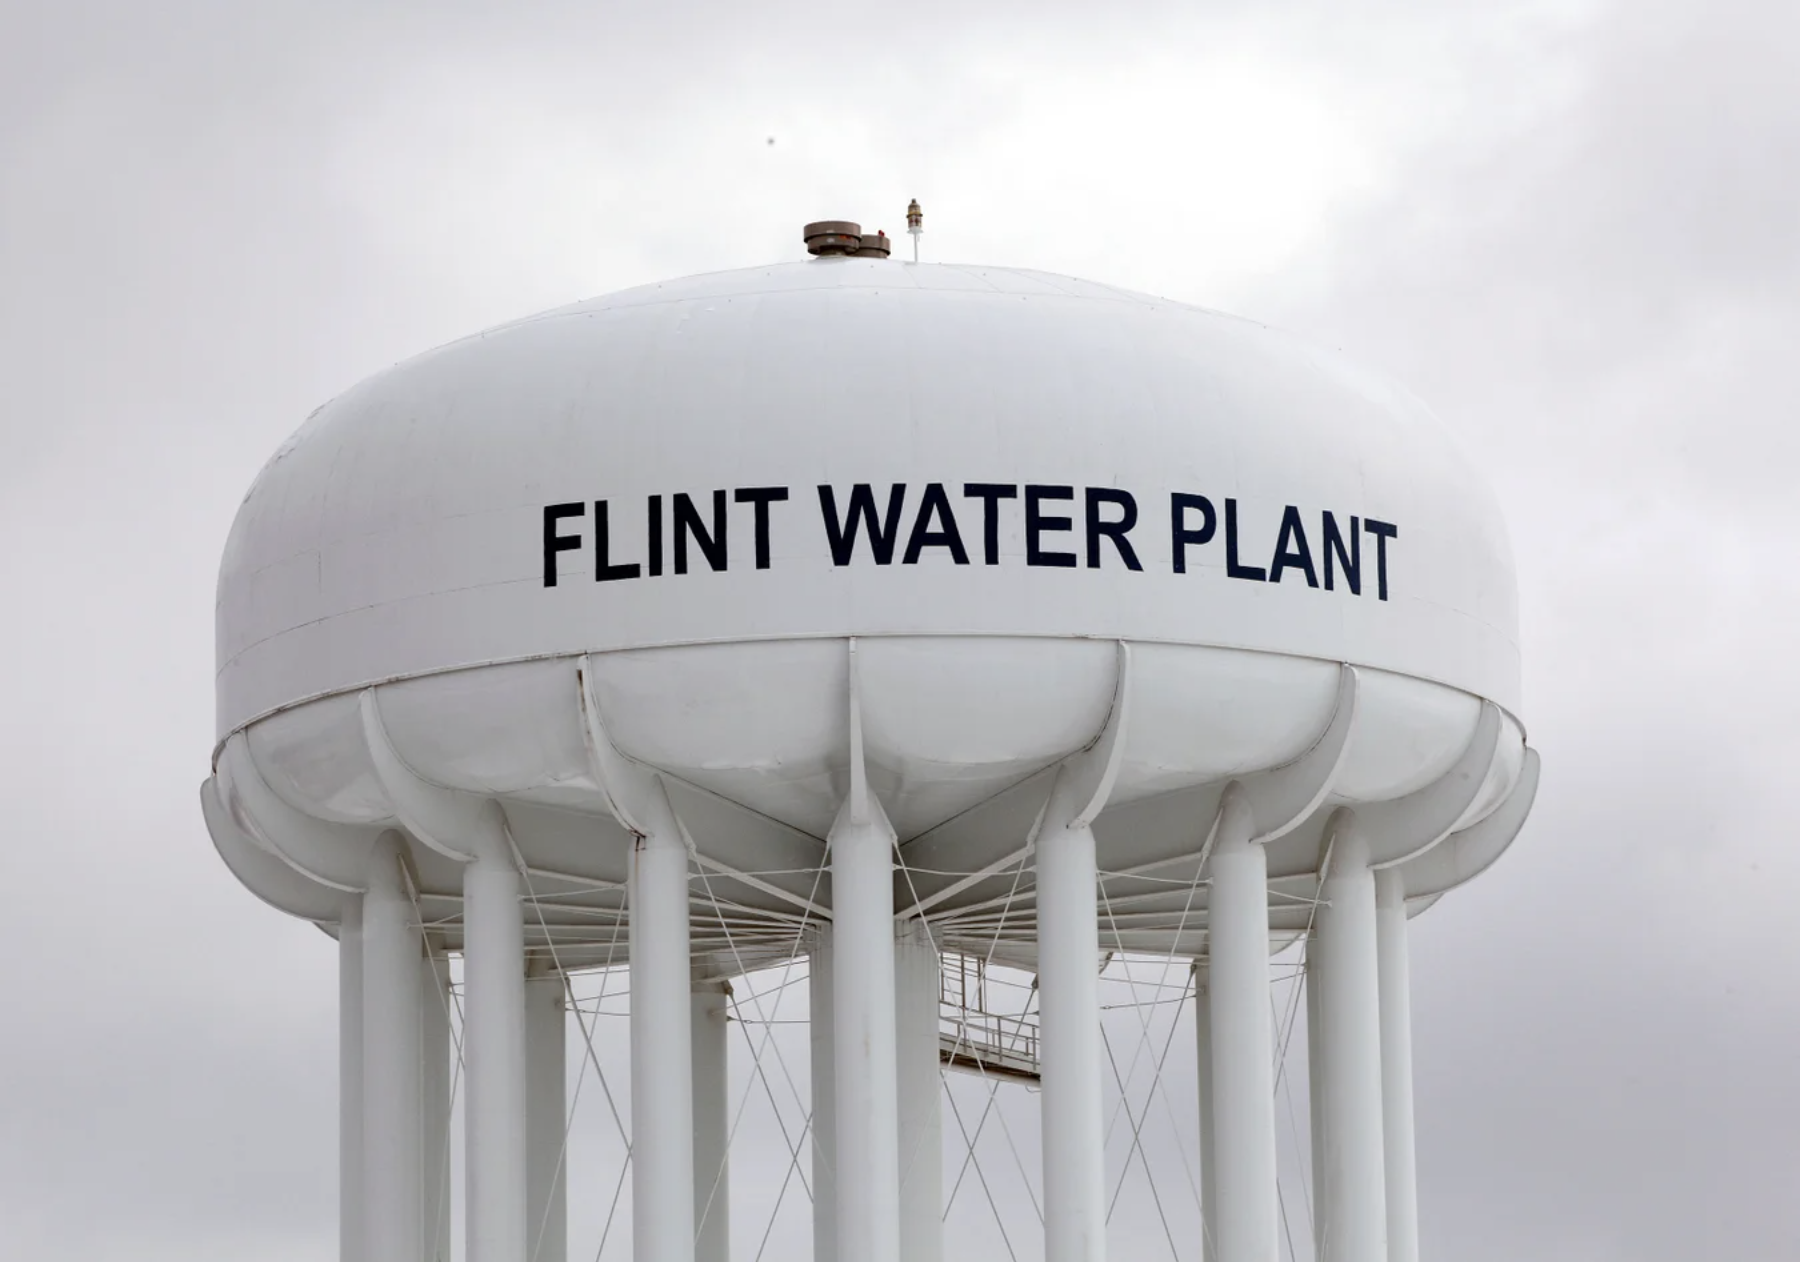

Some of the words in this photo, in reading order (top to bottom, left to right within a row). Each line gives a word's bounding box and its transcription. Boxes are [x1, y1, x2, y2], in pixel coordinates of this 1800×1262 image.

[543, 486, 789, 588] FLINT
[816, 482, 1144, 572] WATER
[1170, 492, 1398, 602] PLANT
